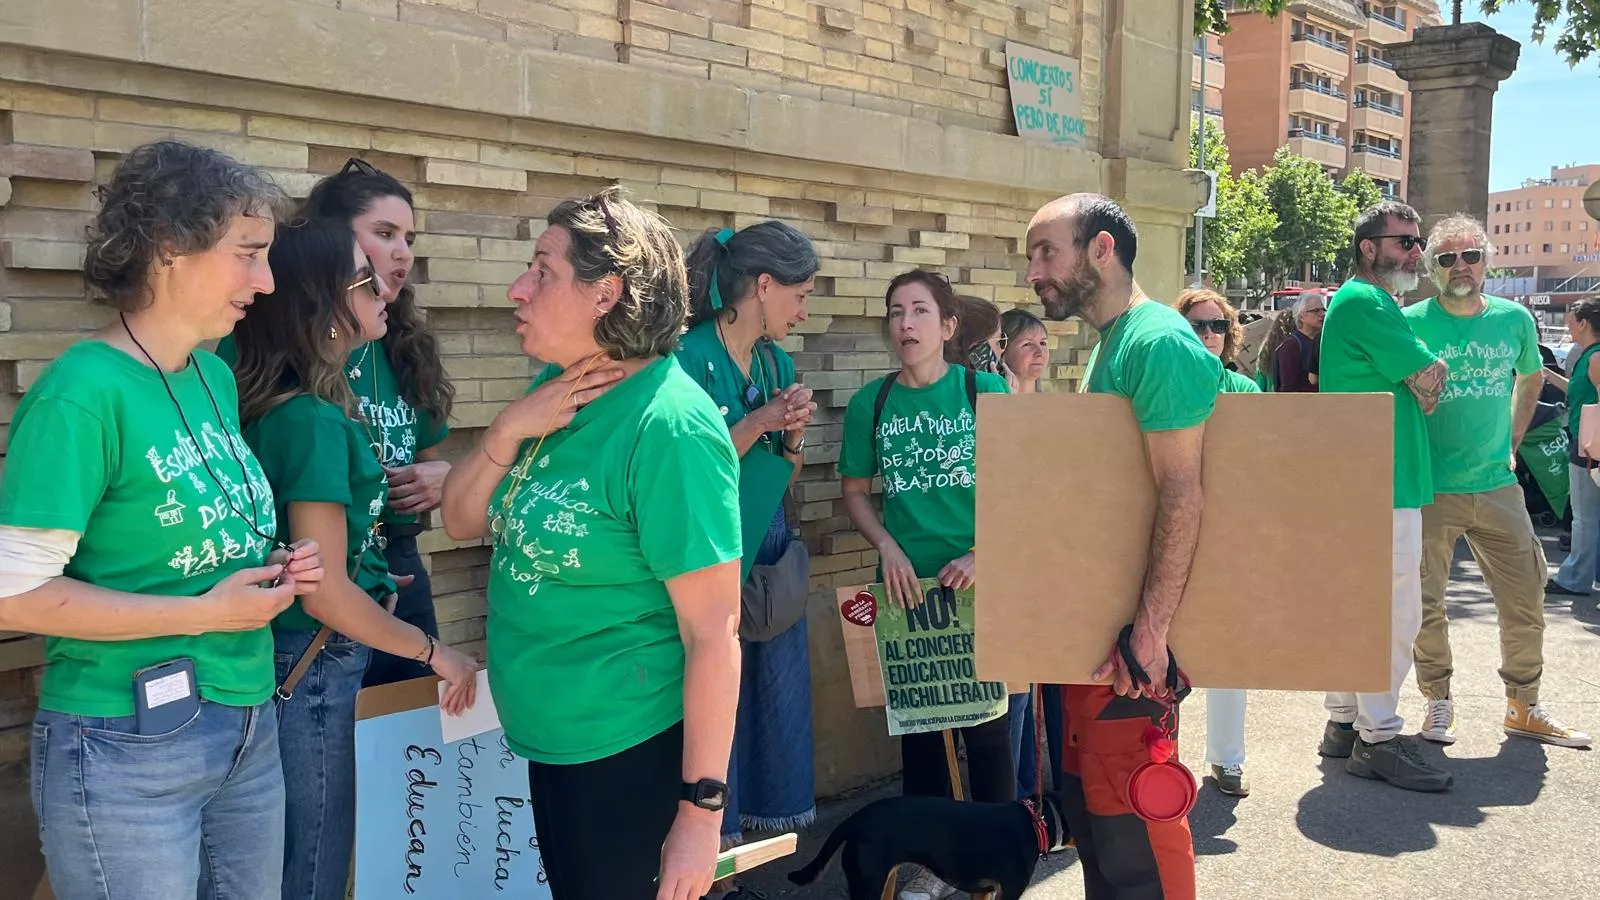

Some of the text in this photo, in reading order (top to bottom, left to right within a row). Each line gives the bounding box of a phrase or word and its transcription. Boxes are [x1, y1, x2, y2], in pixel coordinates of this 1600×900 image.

[1009, 56, 1073, 92] CONCIERTOS
[1046, 111, 1060, 134] DE
[882, 415, 924, 437] CUELA
[882, 446, 973, 469] DE TOD@S
[887, 474, 921, 494] ARA
[198, 496, 228, 529] DE
[904, 586, 960, 632] NO!
[885, 633, 974, 661] AL CONCIER
[888, 657, 973, 685] EDUCATIVO
[889, 681, 1001, 710] BACHILLERATO
[403, 744, 442, 895] Educan
[453, 738, 487, 879] también
[493, 796, 524, 891] lucha
